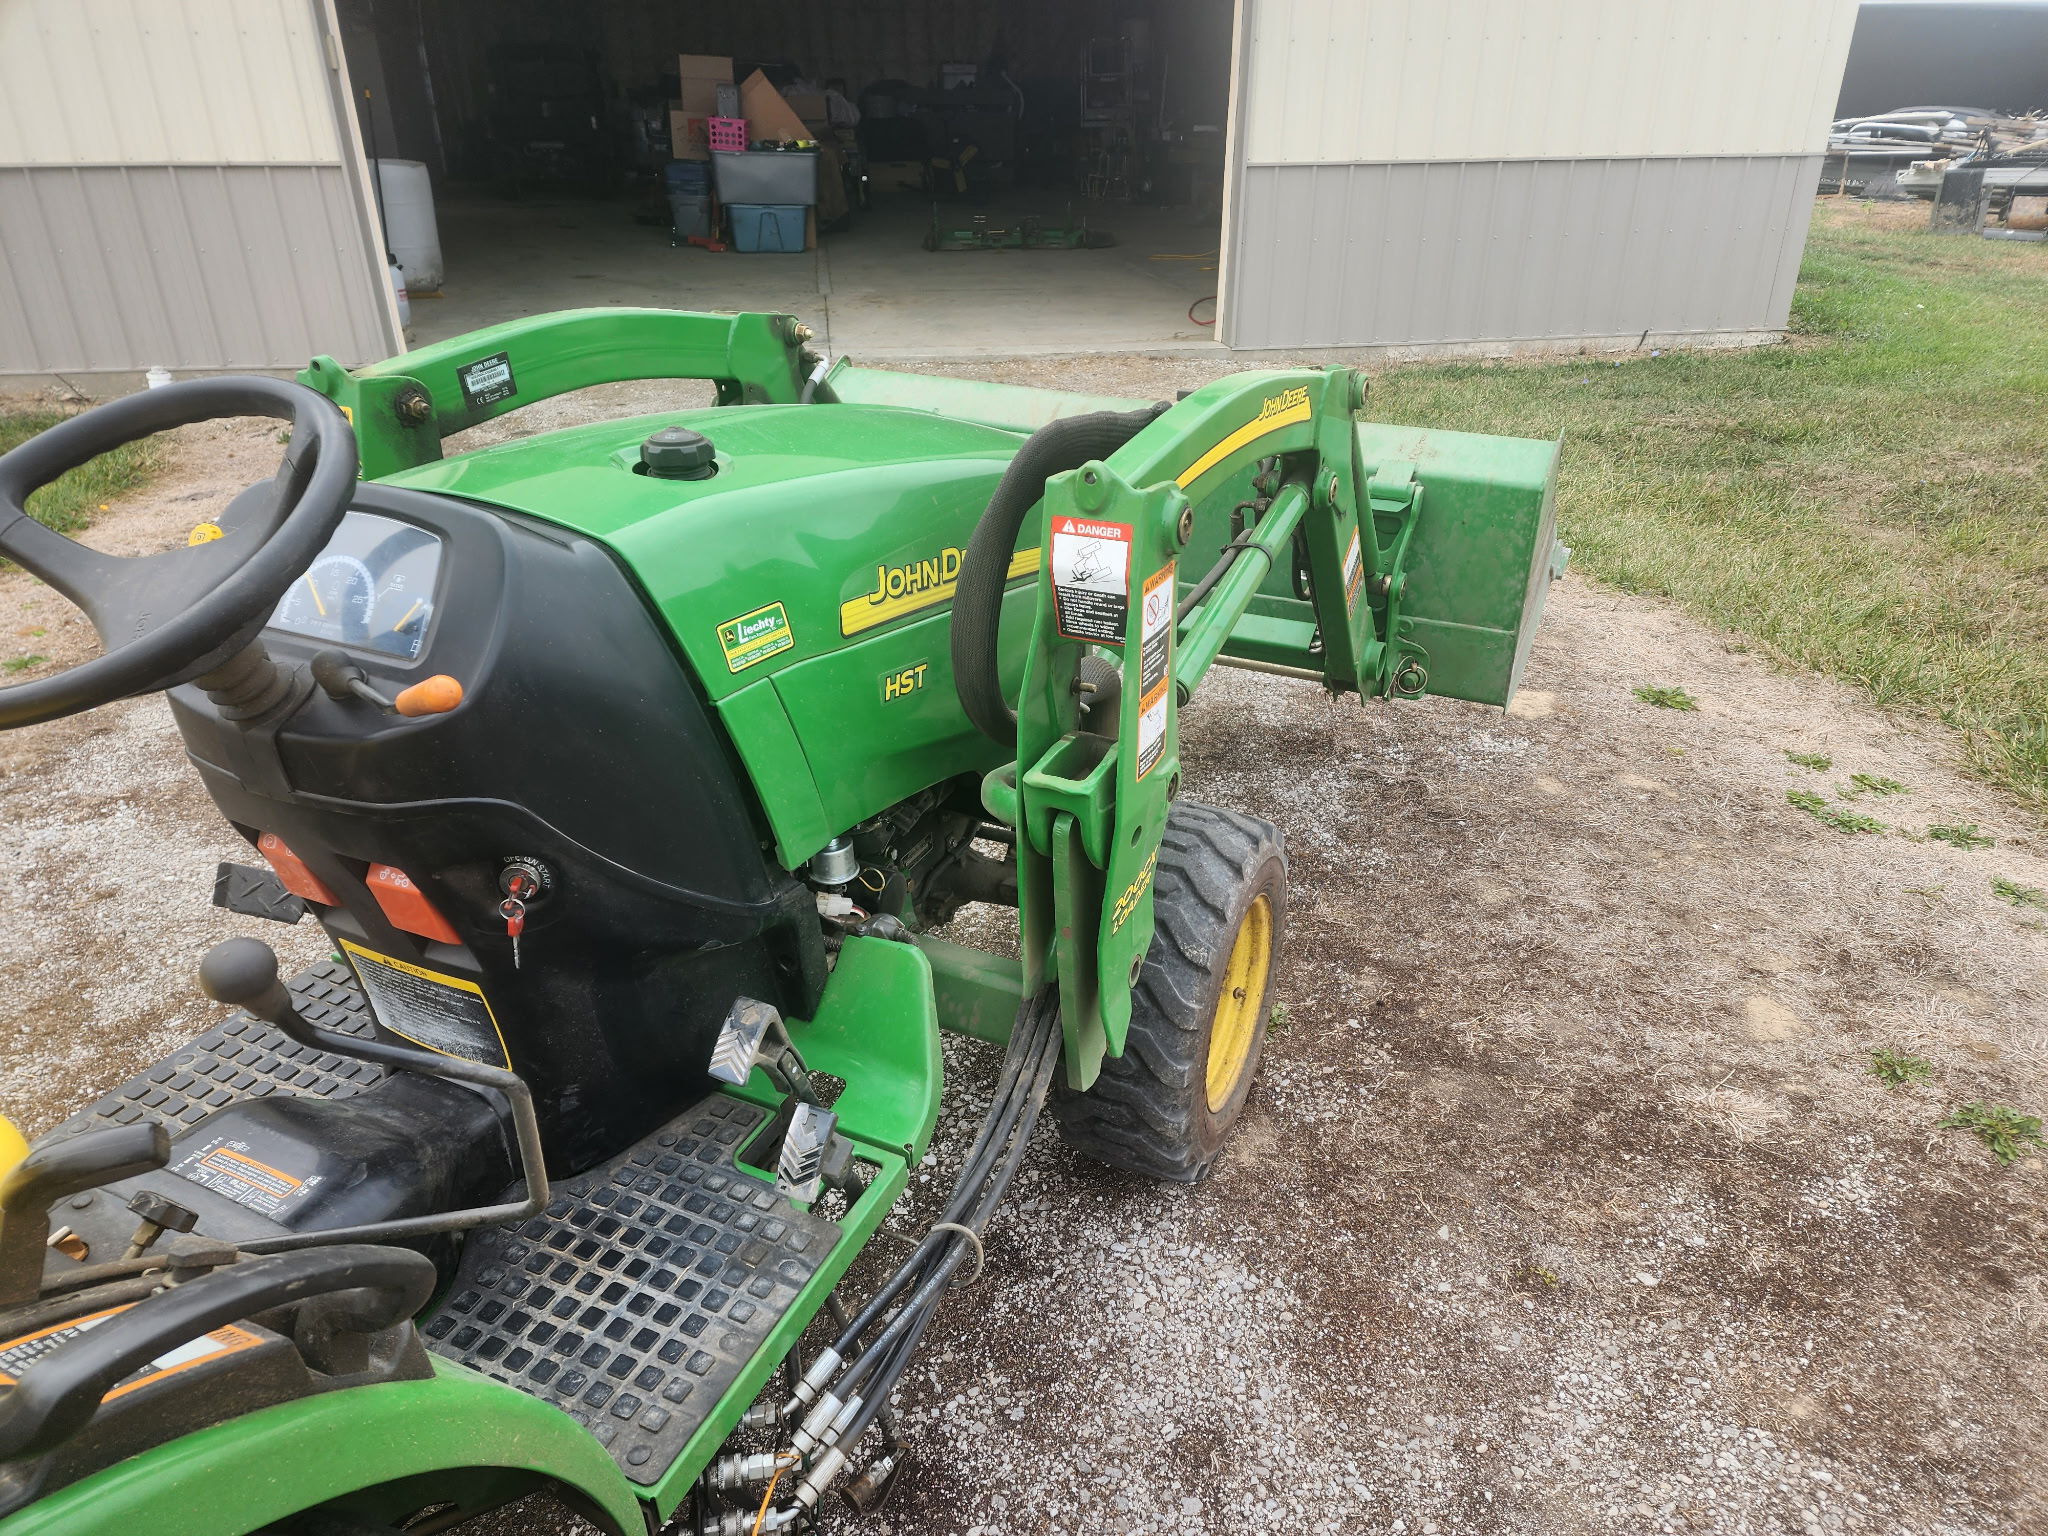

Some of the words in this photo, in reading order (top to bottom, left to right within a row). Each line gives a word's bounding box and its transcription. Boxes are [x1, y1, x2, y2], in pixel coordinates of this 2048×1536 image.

[1259, 395, 1283, 421] JOHN
[1282, 384, 1309, 410] DEERE
[1077, 523, 1121, 539] DANGER
[737, 616, 775, 644] Liechty
[885, 662, 928, 703] HST
[523, 856, 539, 866] ON
[537, 864, 551, 889] START
